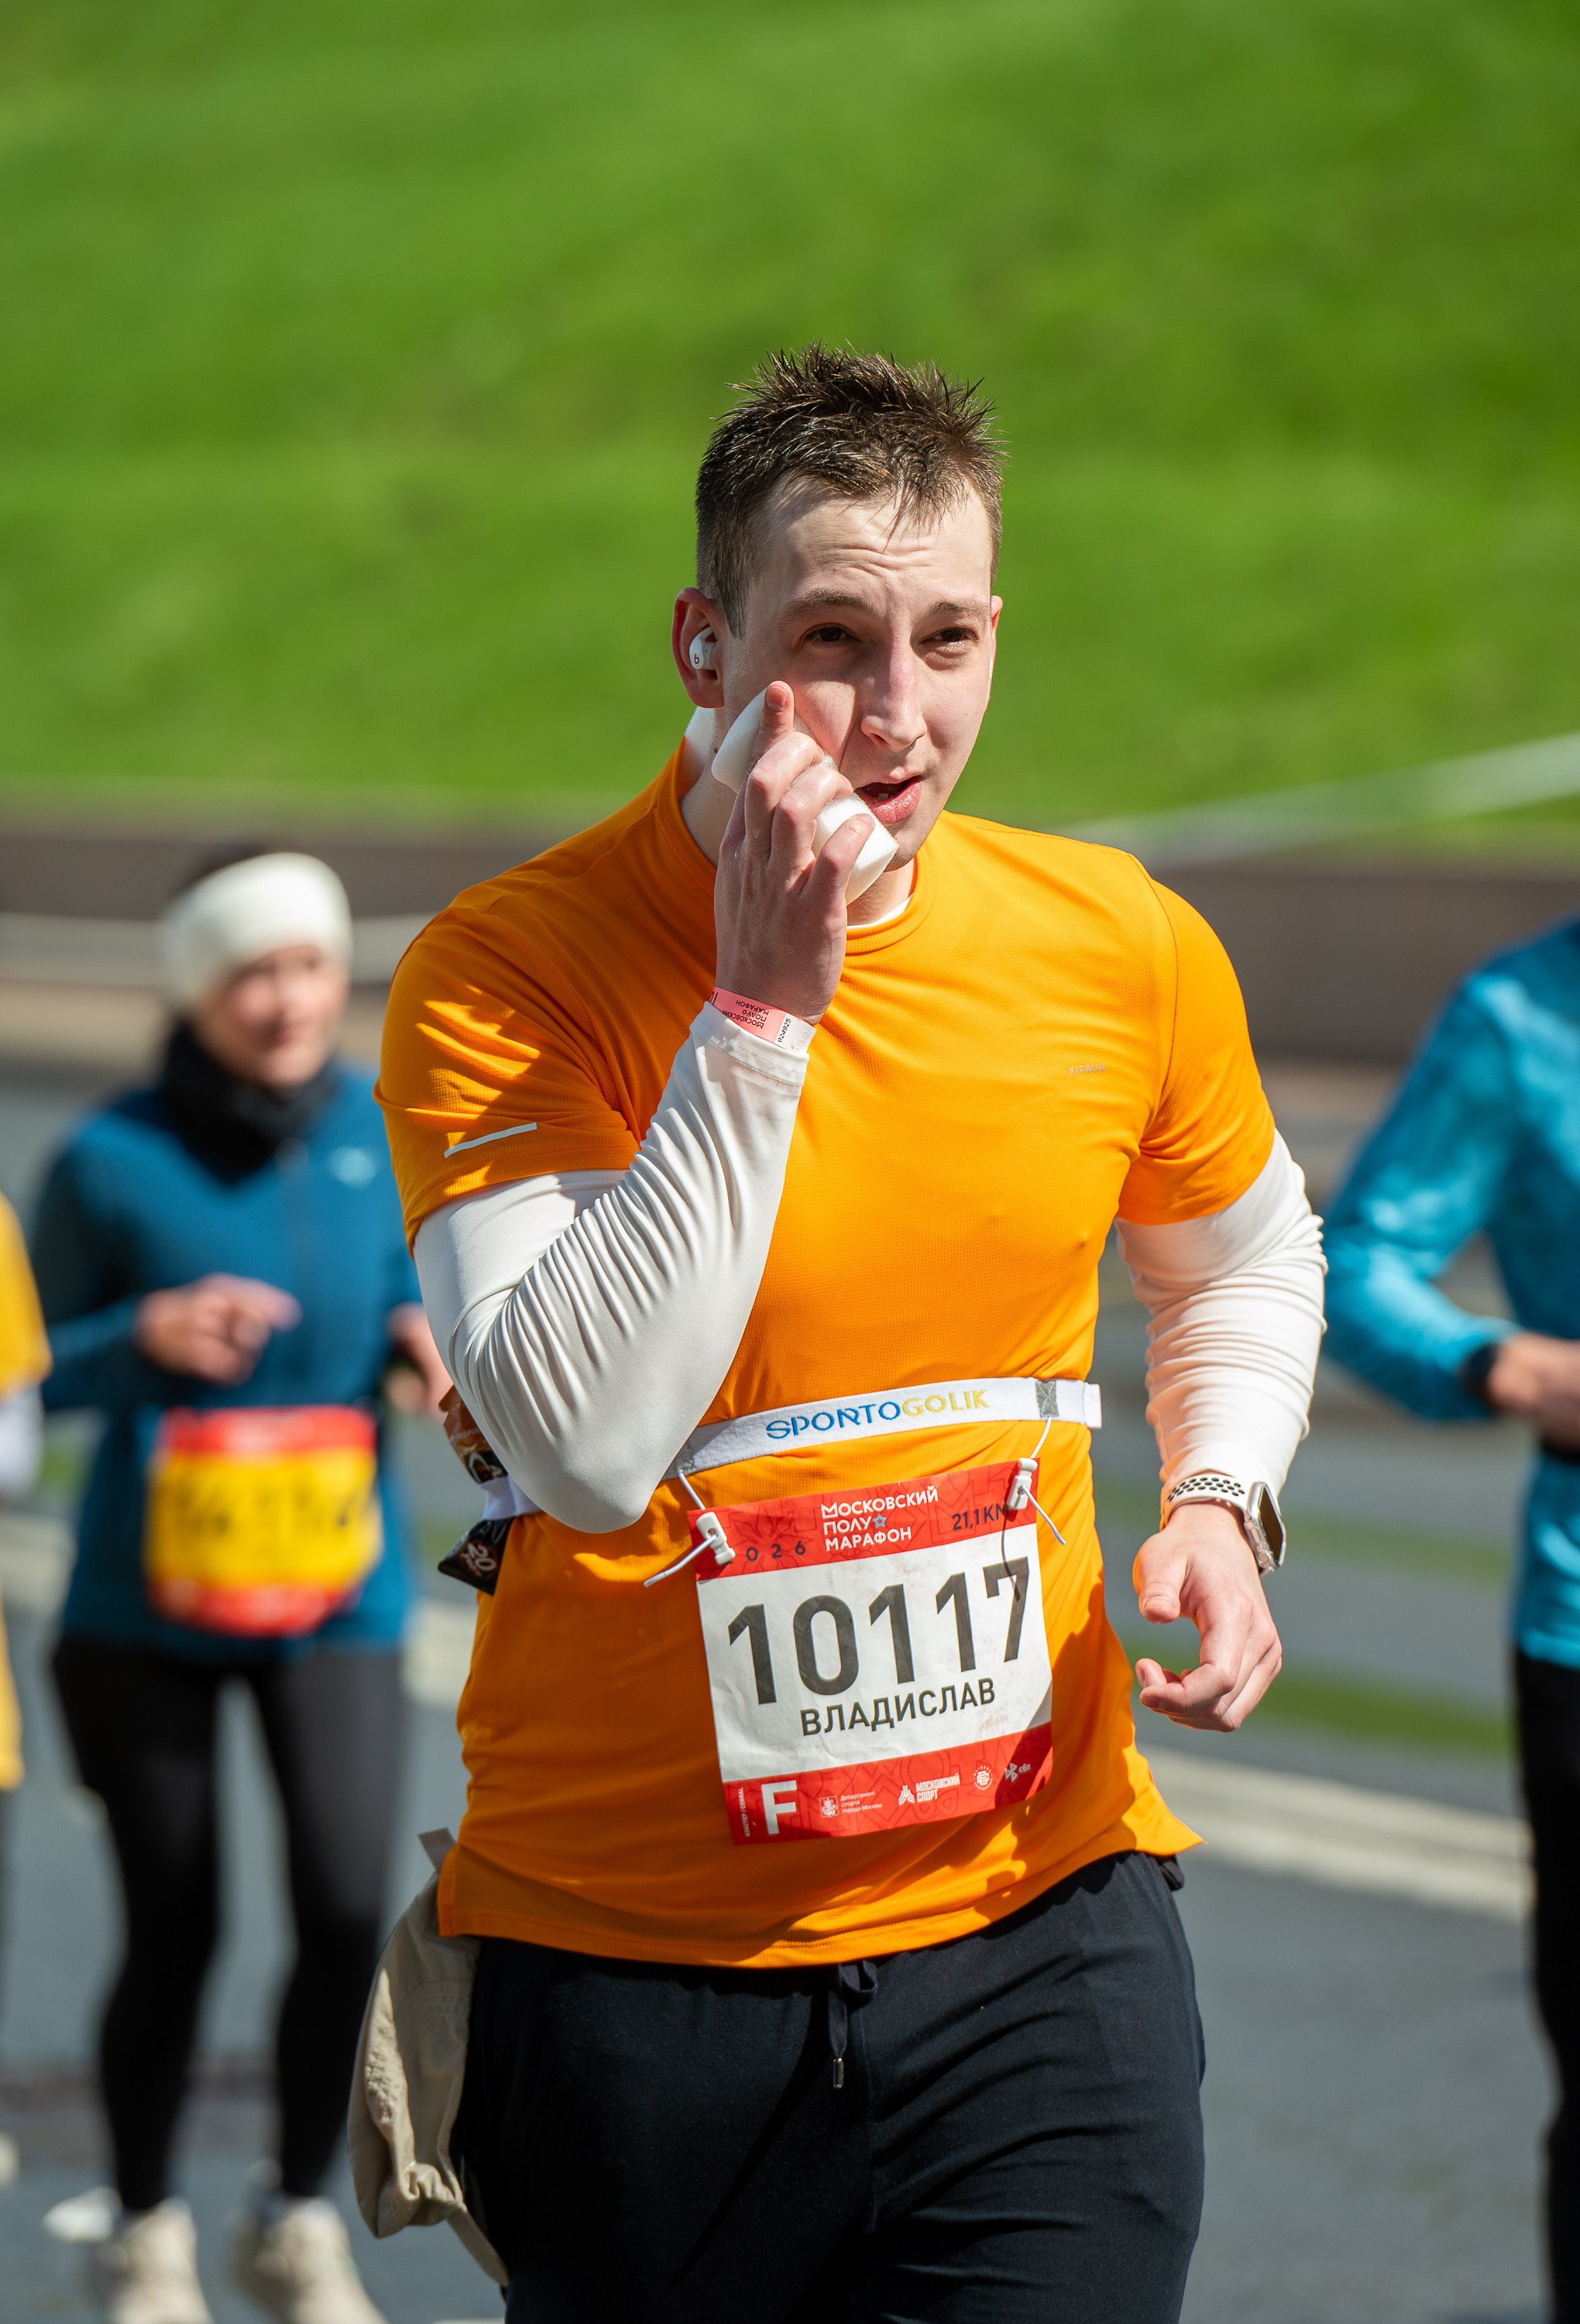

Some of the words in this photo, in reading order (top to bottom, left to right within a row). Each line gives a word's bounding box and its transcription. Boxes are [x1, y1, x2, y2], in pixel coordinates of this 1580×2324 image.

[735, 999, 770, 1016] МАРАФОН
[746, 1012, 768, 1023] ПОЛУ
[1068, 1063, 1105, 1076] KIPRUN
[765, 1389, 989, 1439] SPORTOGOLIK
[821, 1484, 939, 1519] МОСКОВСКИЙ
[823, 1515, 873, 1535] ПОЛУ
[952, 1508, 980, 1532] 21,1
[825, 1526, 912, 1552] МАРАФОН
[724, 1540, 806, 1566] 026
[727, 1556, 1030, 1705] 10117
[800, 1677, 996, 1737] ВЛАДИСЛАВ
[915, 1772, 961, 1792] МОСКОВСКИЙ
[761, 1779, 798, 1835] F
[916, 1789, 939, 1803] СПОРТ
